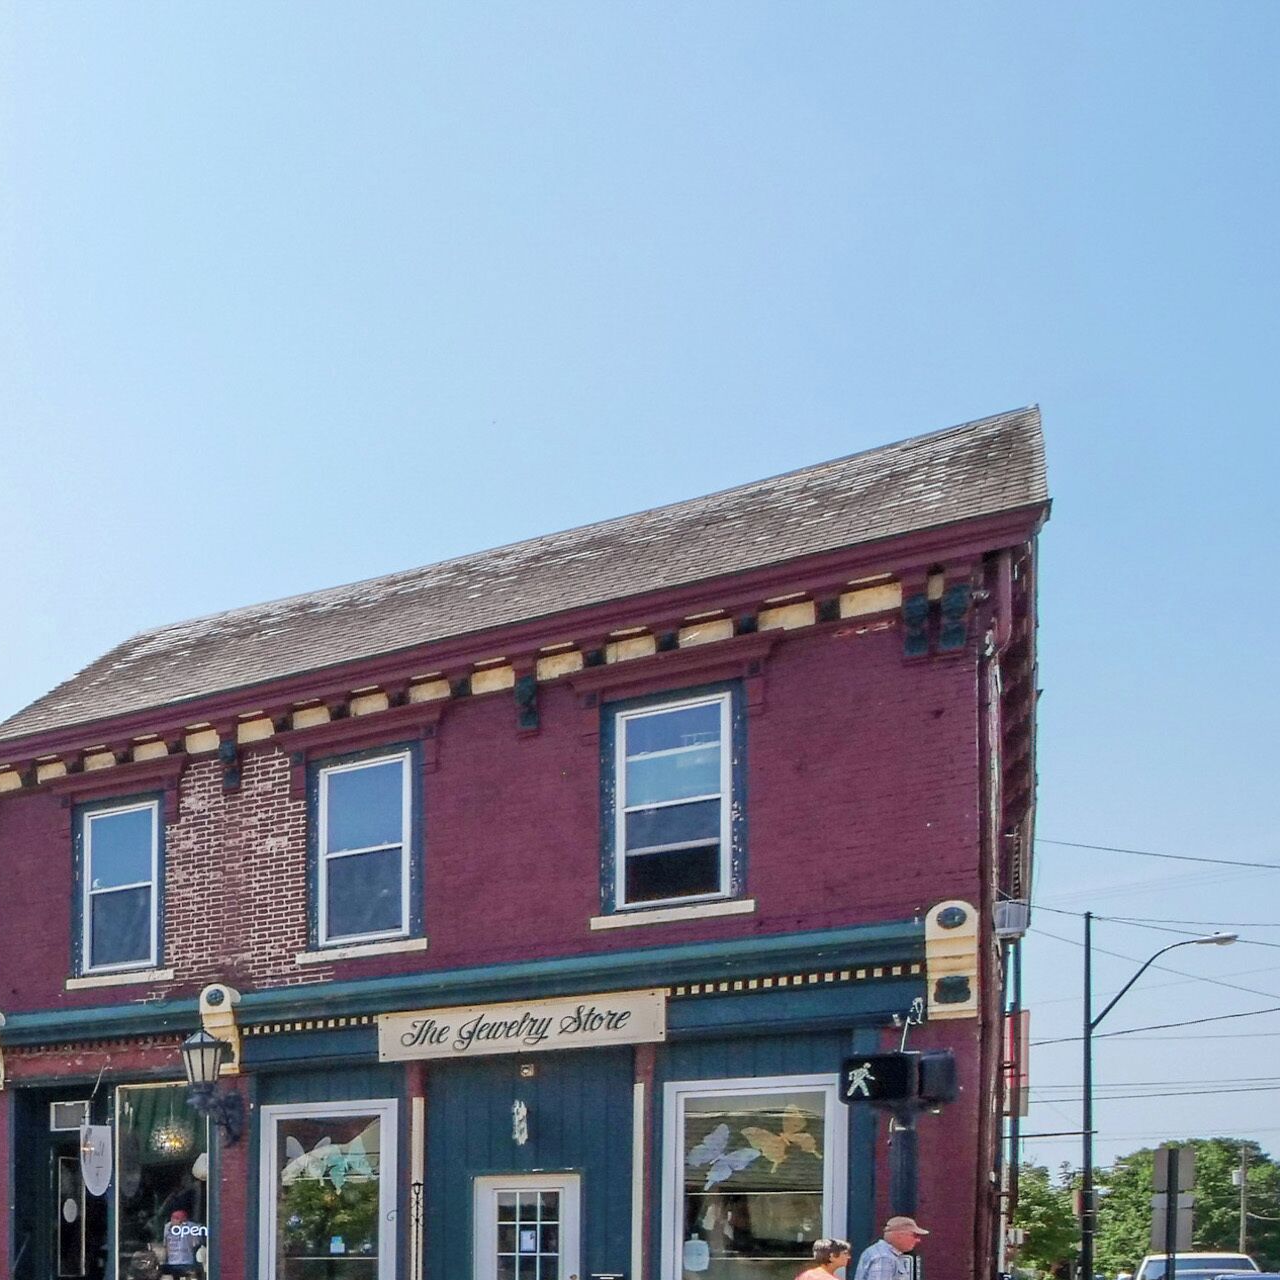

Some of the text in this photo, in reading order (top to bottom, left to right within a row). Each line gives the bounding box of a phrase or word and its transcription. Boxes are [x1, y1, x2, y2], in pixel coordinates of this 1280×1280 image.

[400, 1004, 631, 1051] The Jewelry Store
[171, 1225, 208, 1237] open
